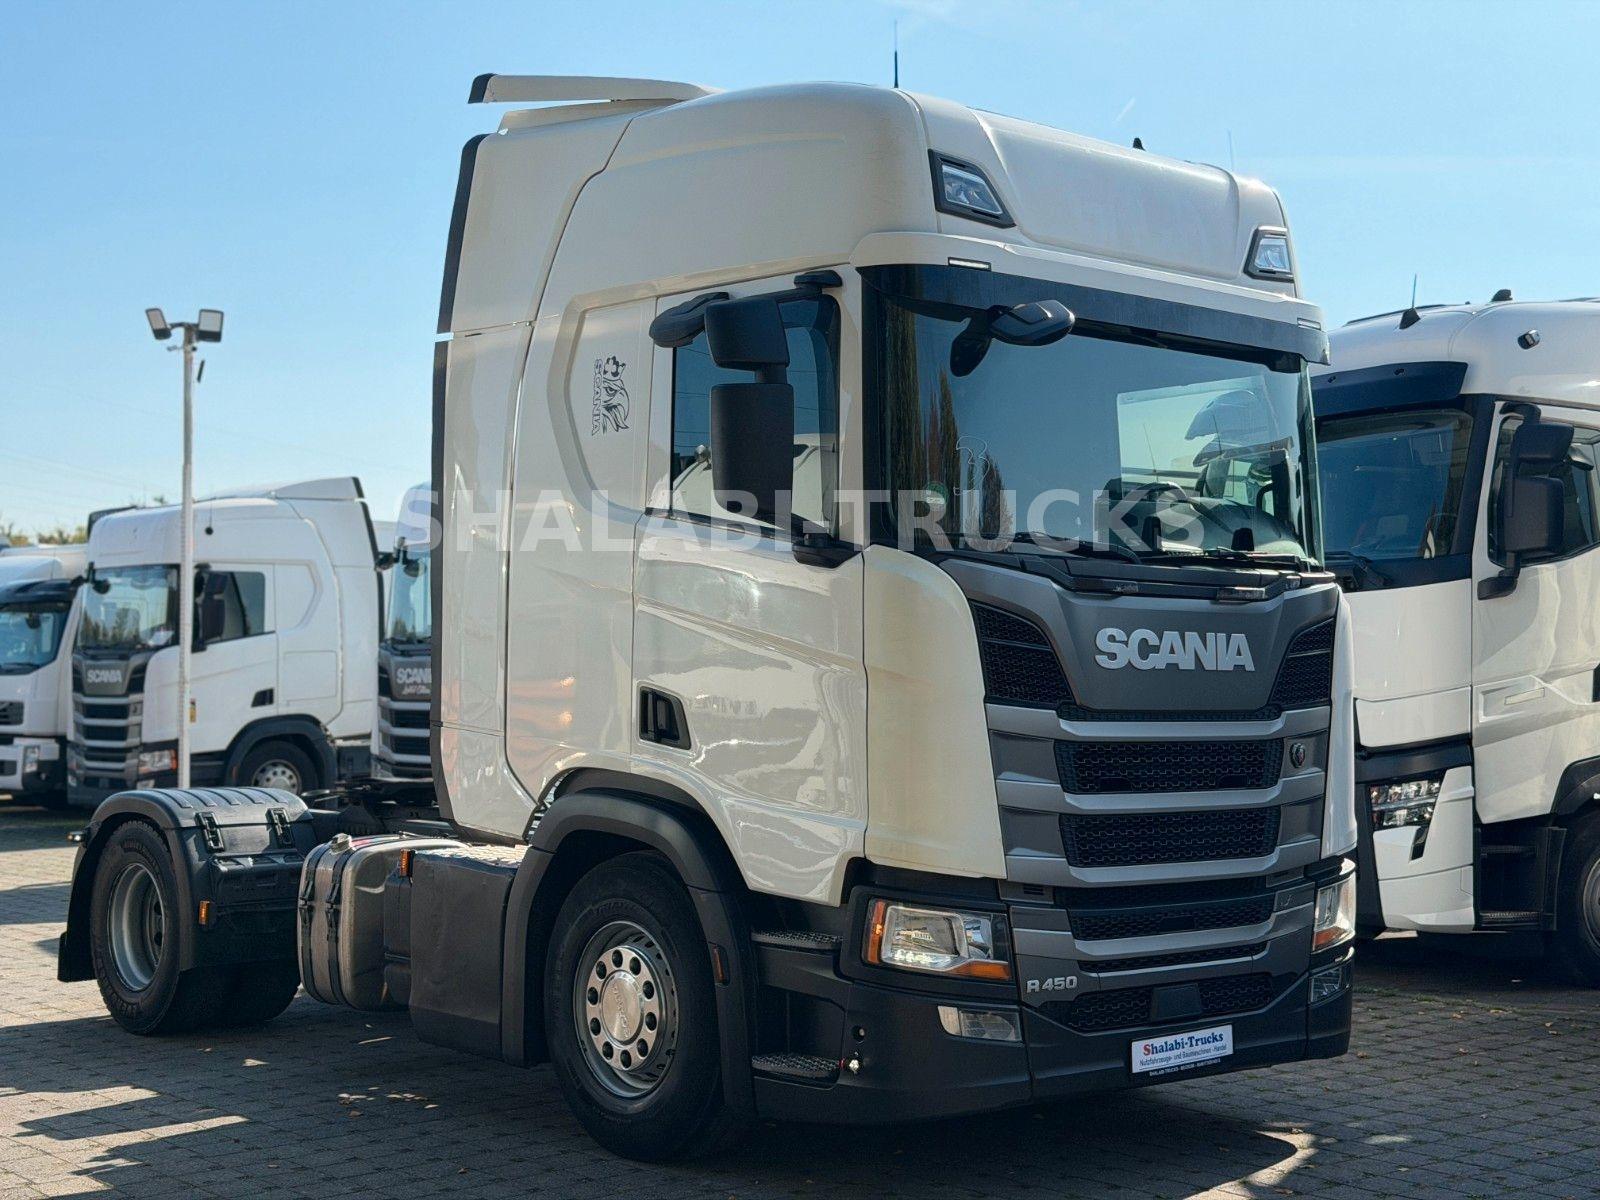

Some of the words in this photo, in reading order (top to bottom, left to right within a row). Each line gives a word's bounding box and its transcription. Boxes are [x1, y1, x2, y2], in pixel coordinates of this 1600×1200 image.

[1094, 627, 1256, 672] SCANIA
[1026, 979, 1040, 993] R
[1042, 975, 1078, 991] 450
[1143, 1032, 1224, 1056] Shalabi-Trucks
